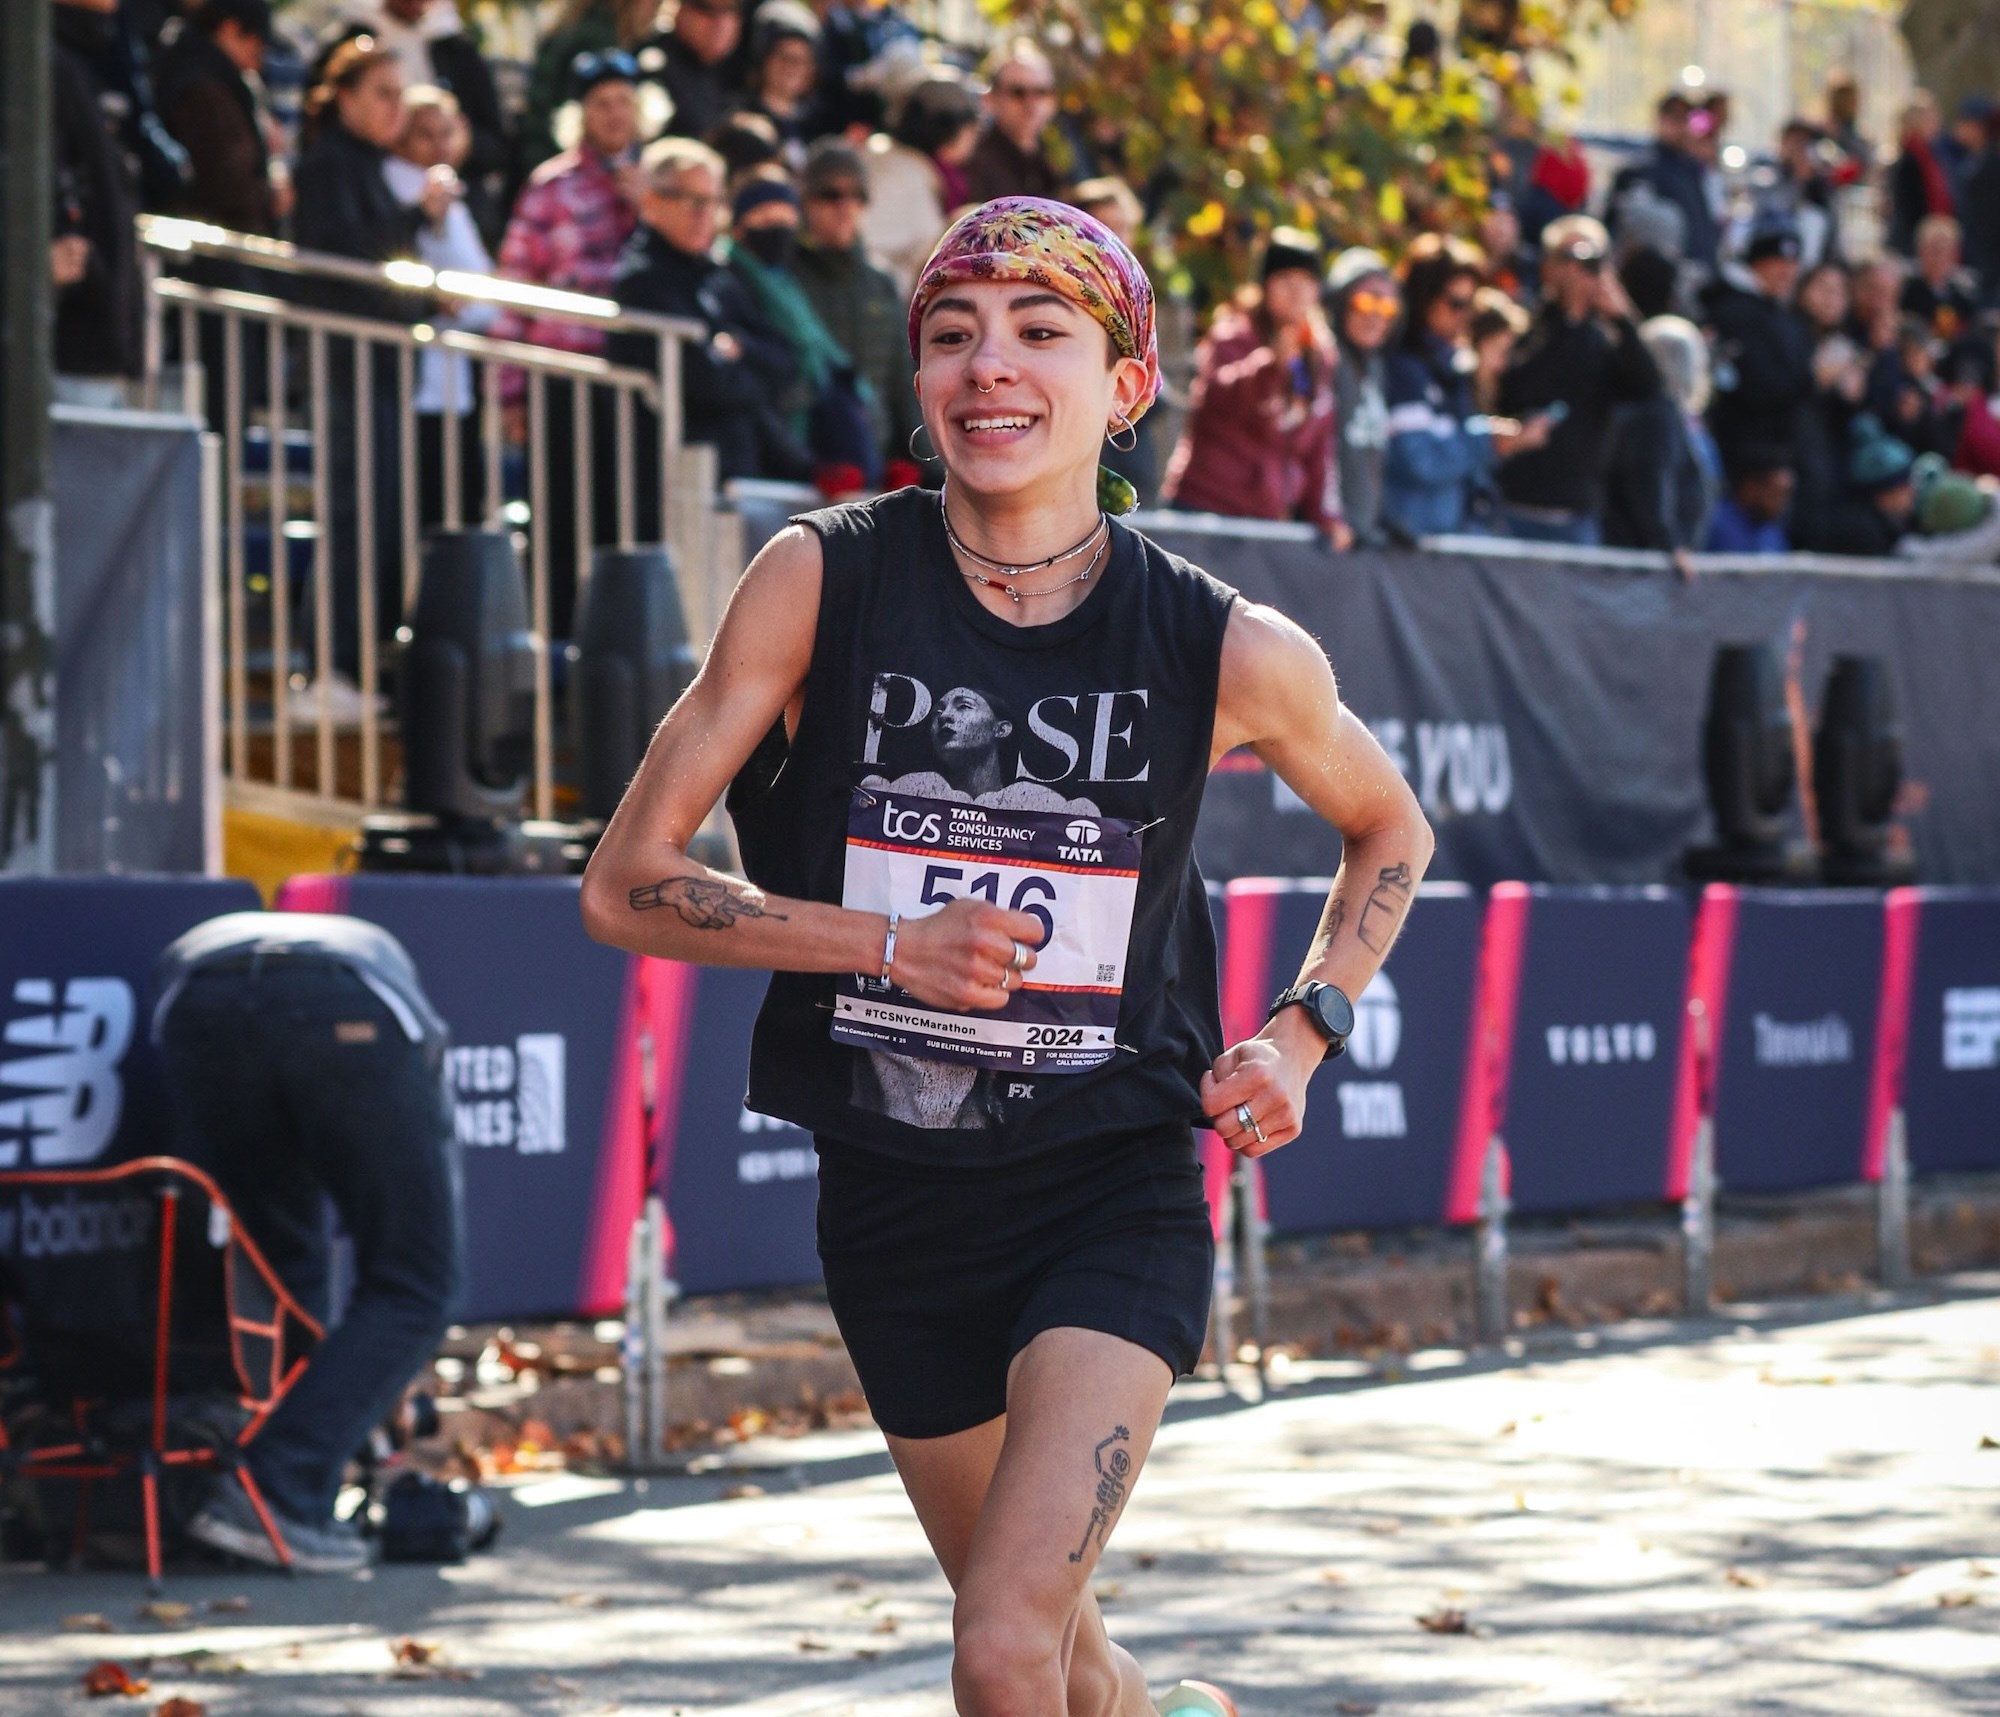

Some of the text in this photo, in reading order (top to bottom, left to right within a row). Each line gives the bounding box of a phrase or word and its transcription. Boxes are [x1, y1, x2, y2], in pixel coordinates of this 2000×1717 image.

[853, 671, 1150, 783] PSE
[1415, 722, 1513, 813] YOU
[882, 799, 942, 844] tcs
[950, 807, 988, 823] TATA
[948, 821, 1037, 842] CONSULTANCY
[946, 835, 1003, 852] SERVICES
[1057, 845, 1104, 863] TATA
[864, 1008, 977, 1036] #TCSNYCMarathon
[1026, 1026, 1084, 1046] 2024
[926, 1040, 940, 1049] SUB
[941, 1042, 961, 1052] ELITE
[960, 1045, 975, 1054] BUS
[976, 1048, 997, 1057] Team:
[1022, 1049, 1036, 1066] B
[1007, 1082, 1035, 1099] FX
